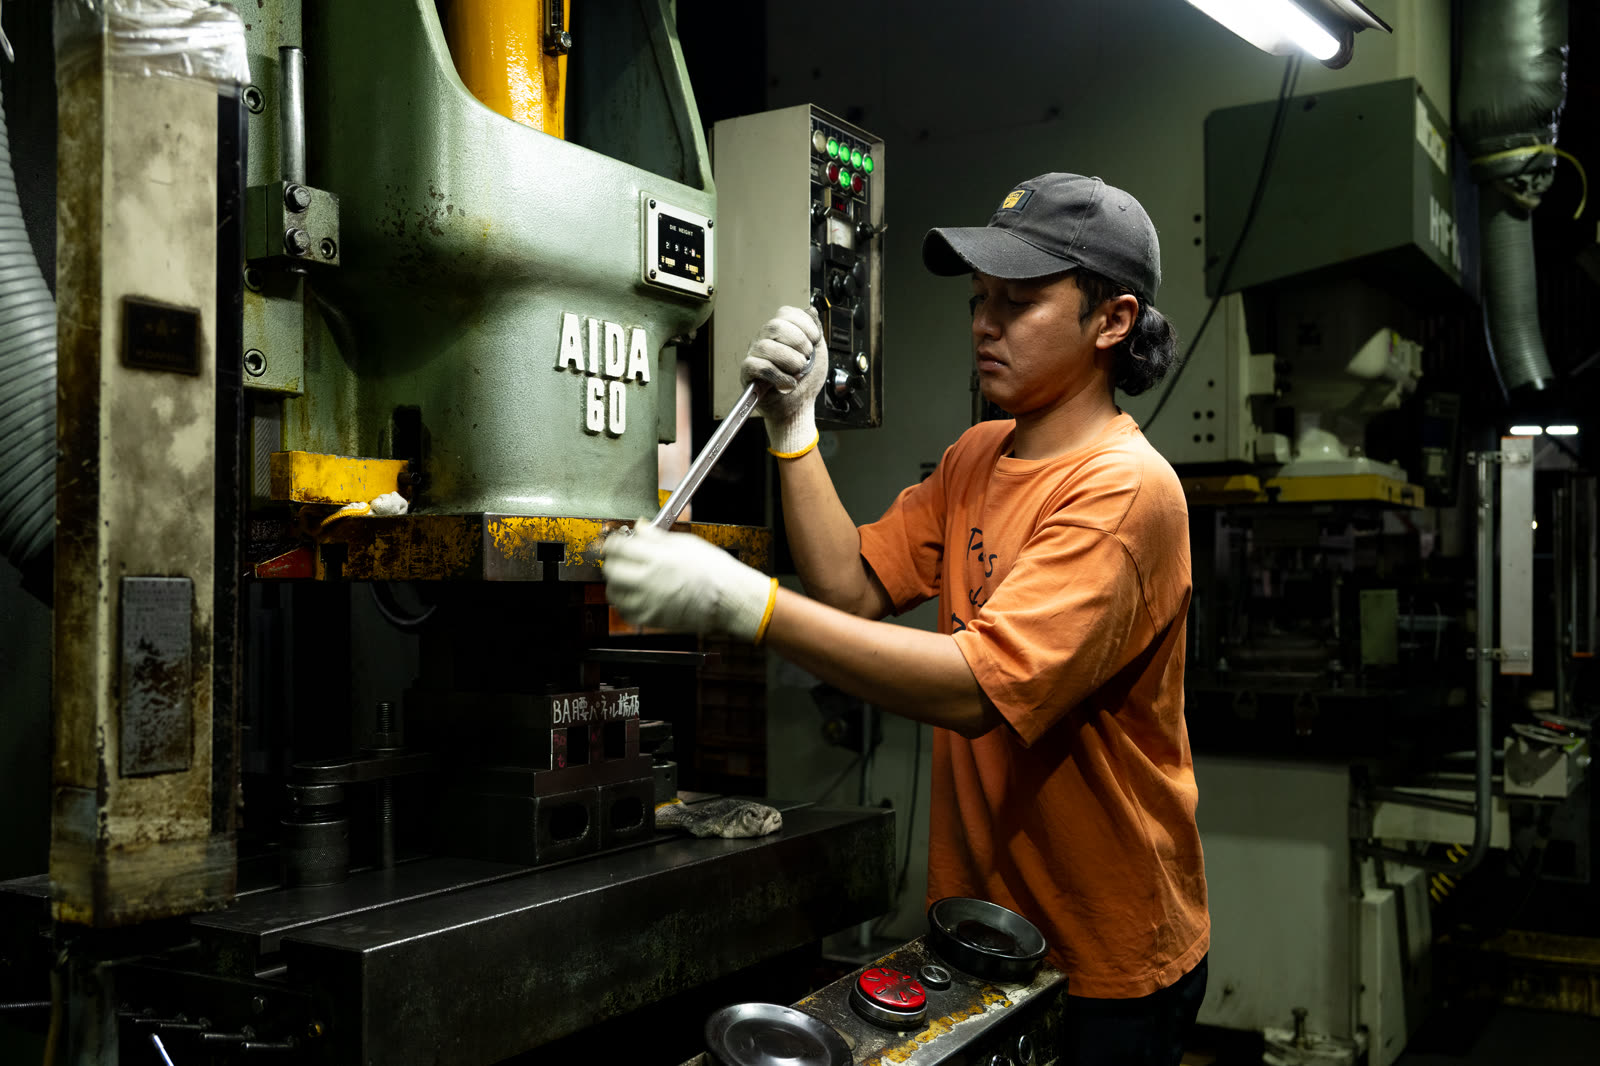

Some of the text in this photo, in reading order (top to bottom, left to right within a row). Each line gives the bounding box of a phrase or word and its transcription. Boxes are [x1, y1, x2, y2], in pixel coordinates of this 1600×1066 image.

[669, 224, 694, 237] DIE HEIGHT
[557, 311, 650, 383] AIDA
[586, 377, 626, 434] 60
